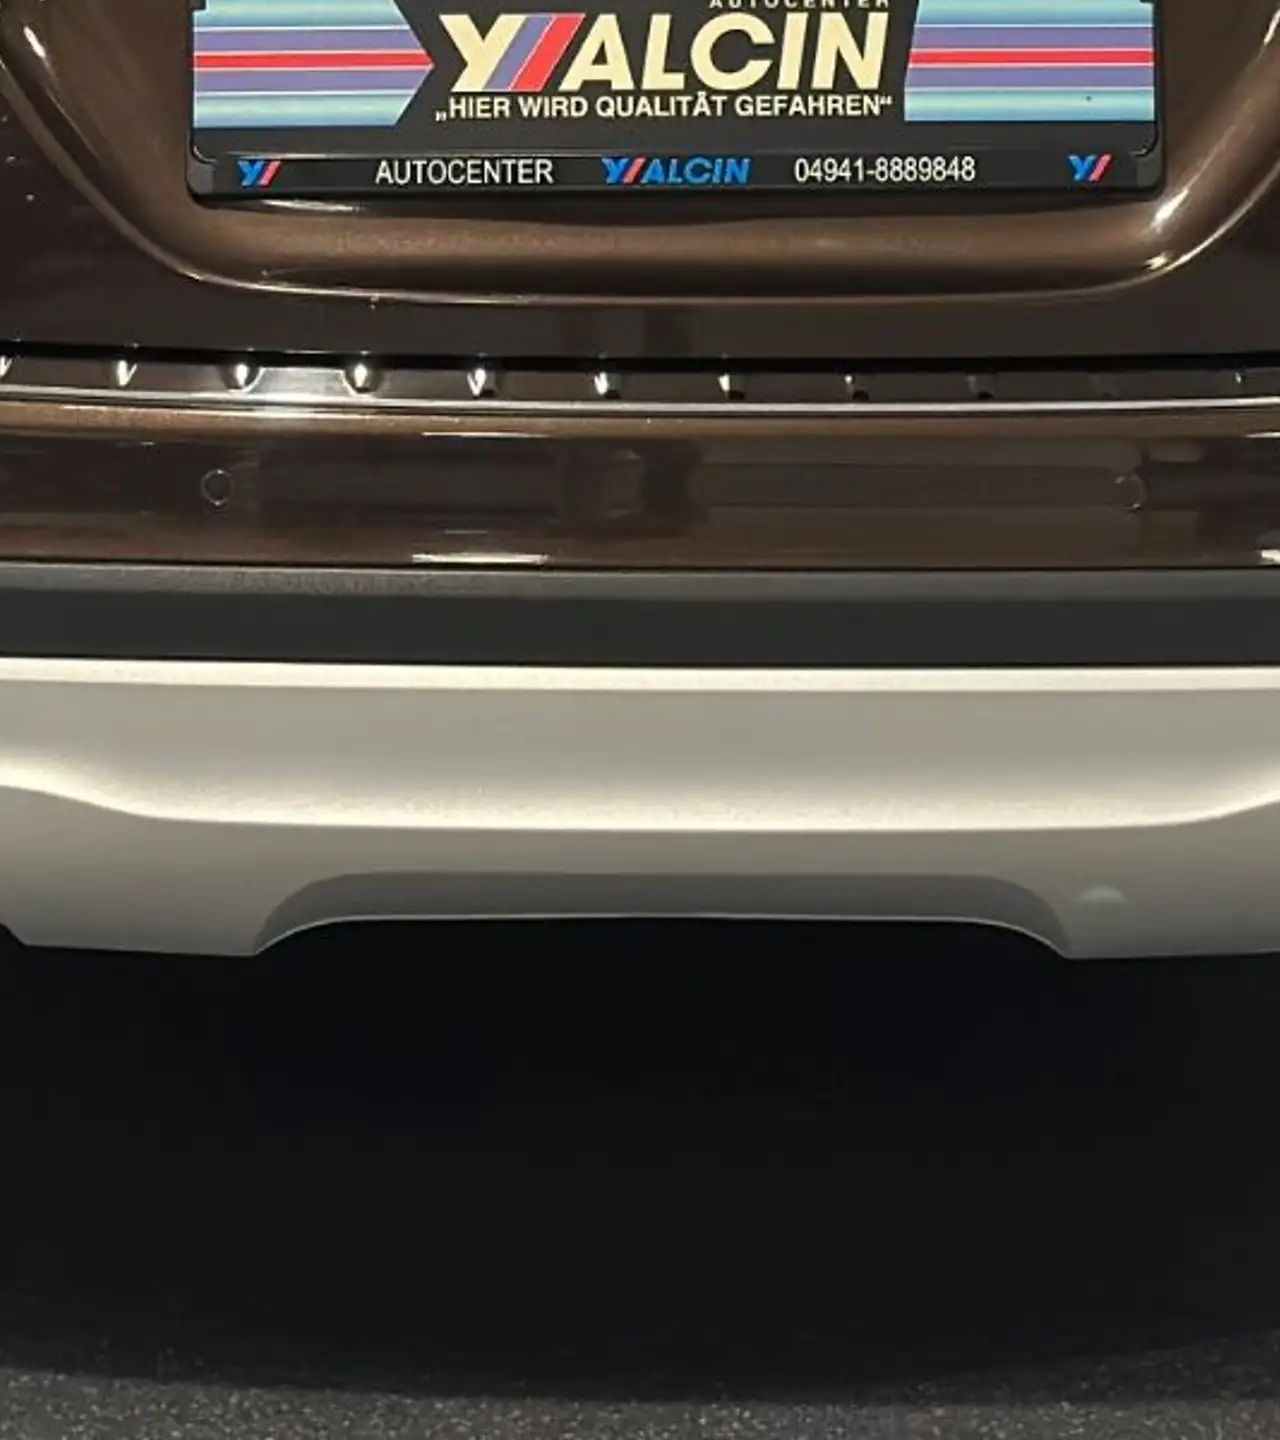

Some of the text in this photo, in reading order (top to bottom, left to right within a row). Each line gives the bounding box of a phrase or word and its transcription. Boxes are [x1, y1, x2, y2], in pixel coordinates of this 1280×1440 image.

[518, 96, 589, 118] WIRD
[595, 91, 728, 118] QUALITÄT
[375, 160, 553, 184] AUTOCENTER
[794, 157, 976, 182] 04941-8889848
